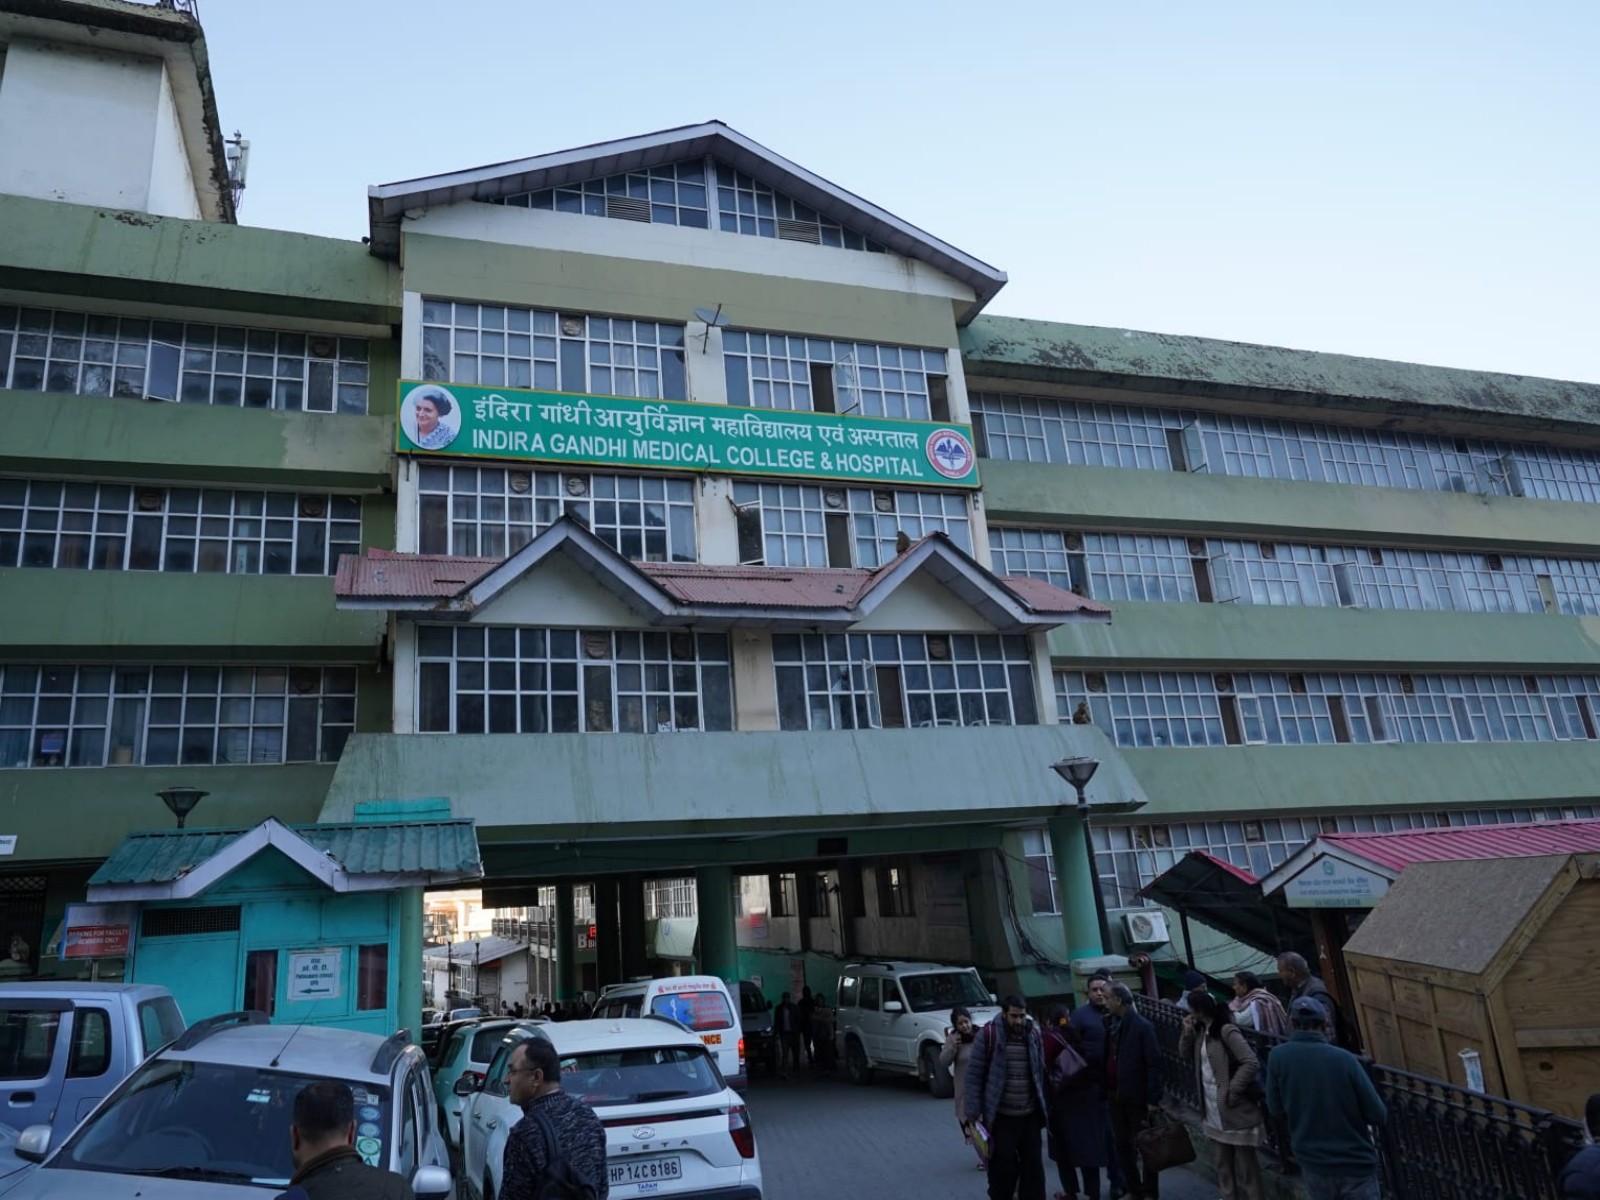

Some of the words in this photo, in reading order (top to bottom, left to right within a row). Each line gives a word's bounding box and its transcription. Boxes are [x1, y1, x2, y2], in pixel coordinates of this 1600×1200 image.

[473, 394, 532, 422] इंदिरा
[538, 401, 592, 426] गांधी
[594, 404, 705, 436] आयुर्विज्ञान
[711, 413, 812, 442] महाविद्यालय
[818, 423, 844, 447] एवं
[849, 428, 918, 450] अस्पताल
[472, 429, 546, 453] INDIRA
[550, 433, 628, 458] GANDHI
[633, 439, 721, 464] MEDICAL
[726, 445, 815, 470] COLLEGE
[820, 452, 834, 471] &
[836, 454, 924, 477] HOSPITAL
[701, 1034, 721, 1045] NCE
[637, 1181, 658, 1190] TAPAN
